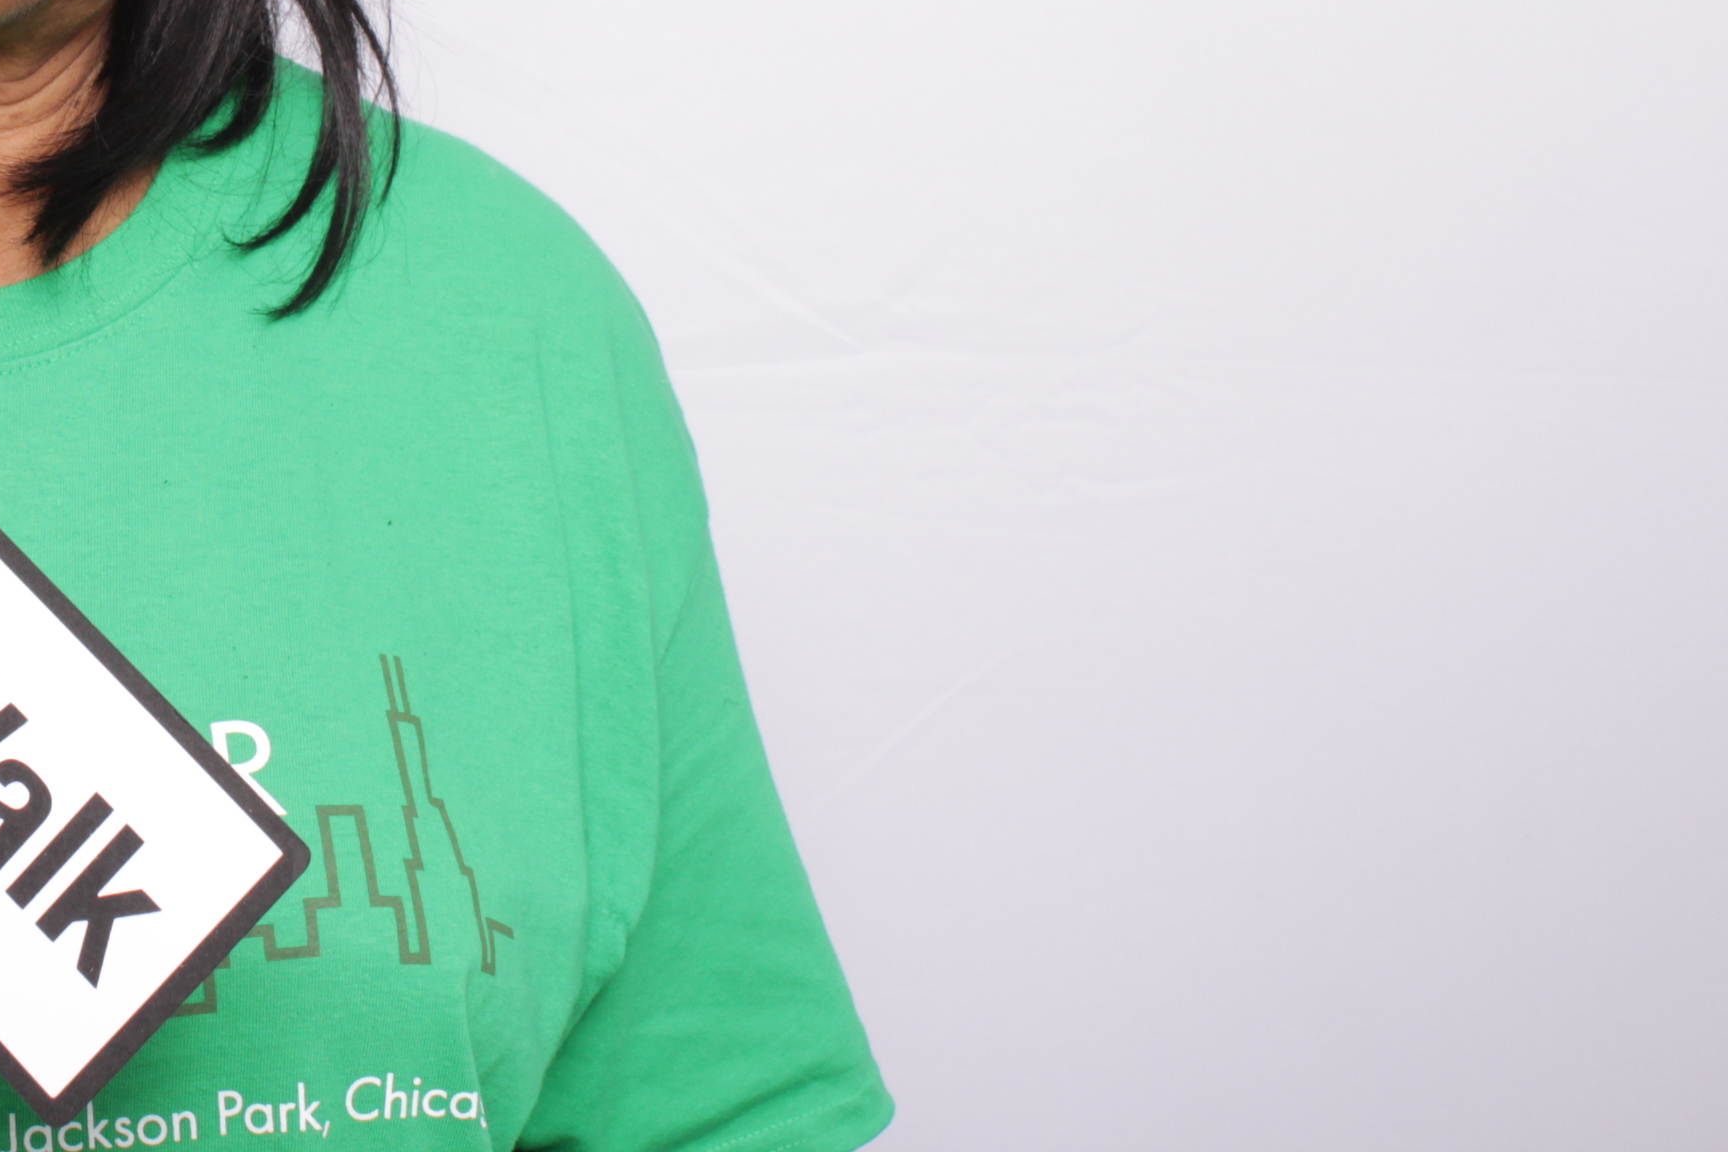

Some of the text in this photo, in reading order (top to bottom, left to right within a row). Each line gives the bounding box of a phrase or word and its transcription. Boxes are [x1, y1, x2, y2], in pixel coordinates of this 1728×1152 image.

[1, 1072, 488, 1152] Jackson Park, Chica
